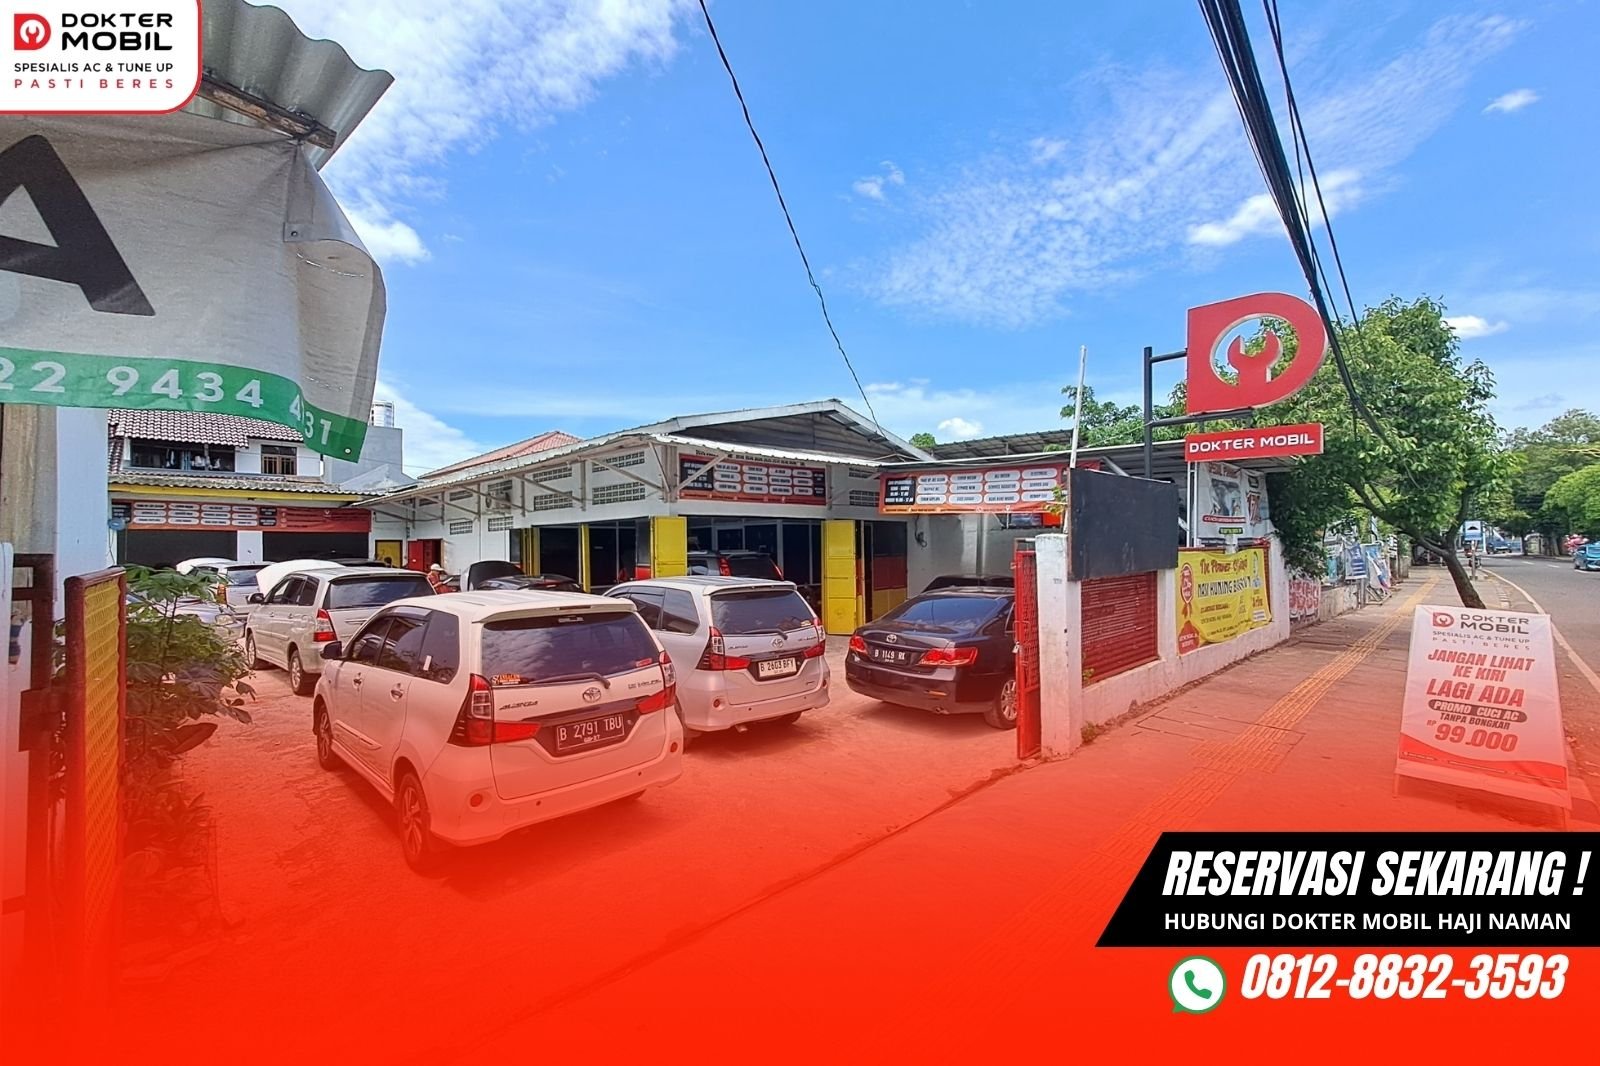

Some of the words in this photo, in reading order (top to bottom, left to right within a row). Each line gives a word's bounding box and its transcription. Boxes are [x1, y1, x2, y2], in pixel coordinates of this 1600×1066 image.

[106, 365, 264, 408] 9434
[1189, 438, 1255, 453] DOKTER
[1260, 433, 1315, 448] MOBIL
[1460, 613, 1529, 625] DOKTER
[1460, 621, 1529, 634] MOBIL
[1432, 630, 1471, 639] SPESIALIS
[760, 663, 765, 672] B
[1427, 649, 1487, 666] JANGAN
[1490, 655, 1535, 671] LIHAT
[1453, 665, 1473, 678] KE
[1475, 667, 1507, 682] KIRI
[1426, 678, 1475, 700] LAGI
[1478, 685, 1525, 707] ADA
[1433, 701, 1472, 714] PROMO
[1476, 707, 1501, 718] CUCI
[1502, 710, 1520, 721] AC
[1440, 712, 1467, 723] TANPA
[1469, 717, 1511, 730] BONGKAR
[559, 727, 567, 741] B
[573, 720, 598, 739] 2791
[603, 716, 622, 731] TBU
[1434, 723, 1519, 752] 99.000
